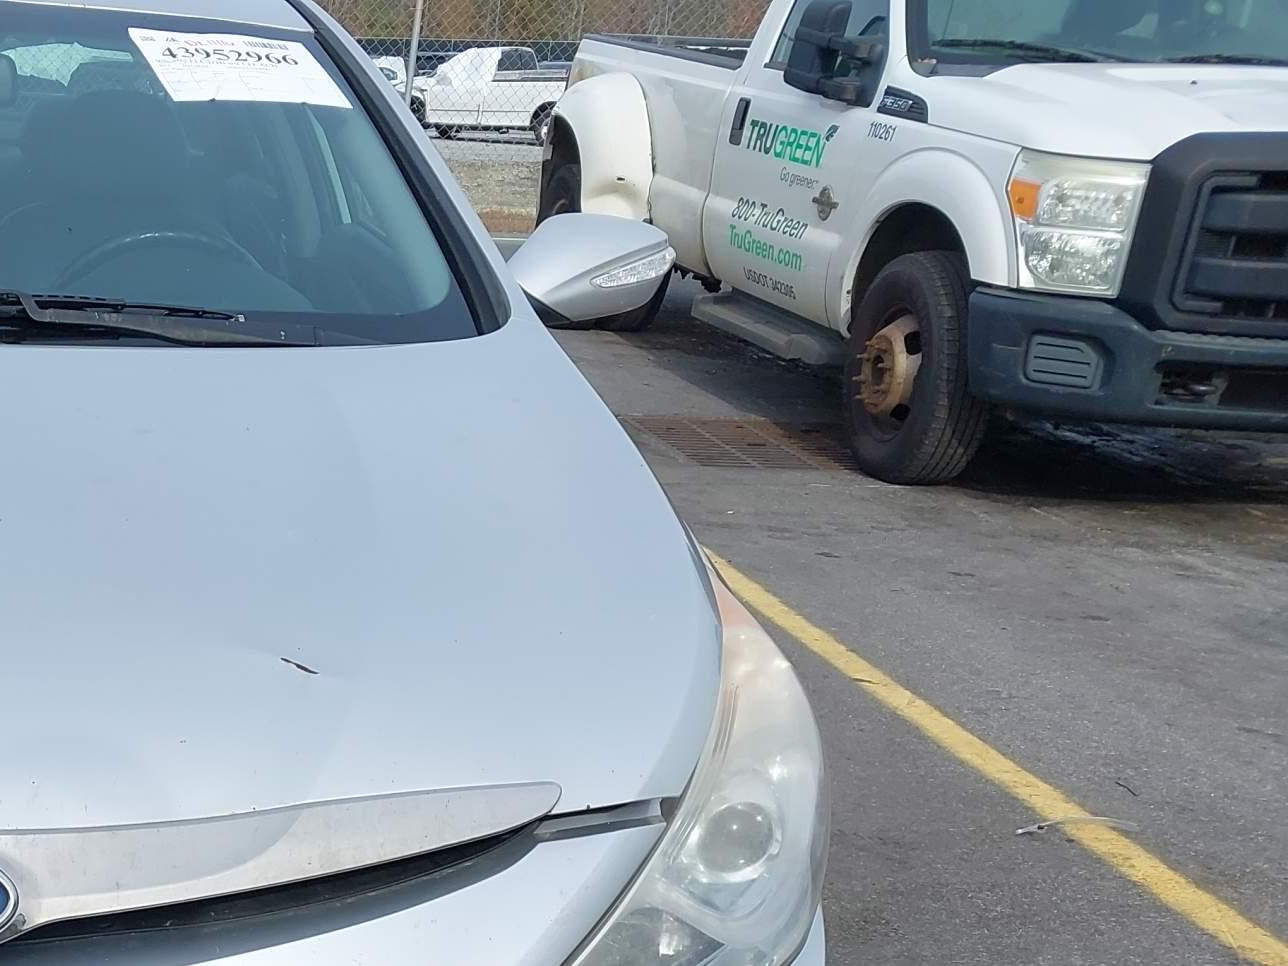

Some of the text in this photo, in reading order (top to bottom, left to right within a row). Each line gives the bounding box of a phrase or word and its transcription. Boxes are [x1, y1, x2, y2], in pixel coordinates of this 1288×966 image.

[162, 46, 299, 66] 43952966
[747, 119, 827, 168] TRUGREEN
[867, 121, 897, 142] 110261
[731, 197, 808, 240] 800-TruGreen
[729, 224, 802, 271] TruGreen.com
[743, 265, 769, 288] USDOT
